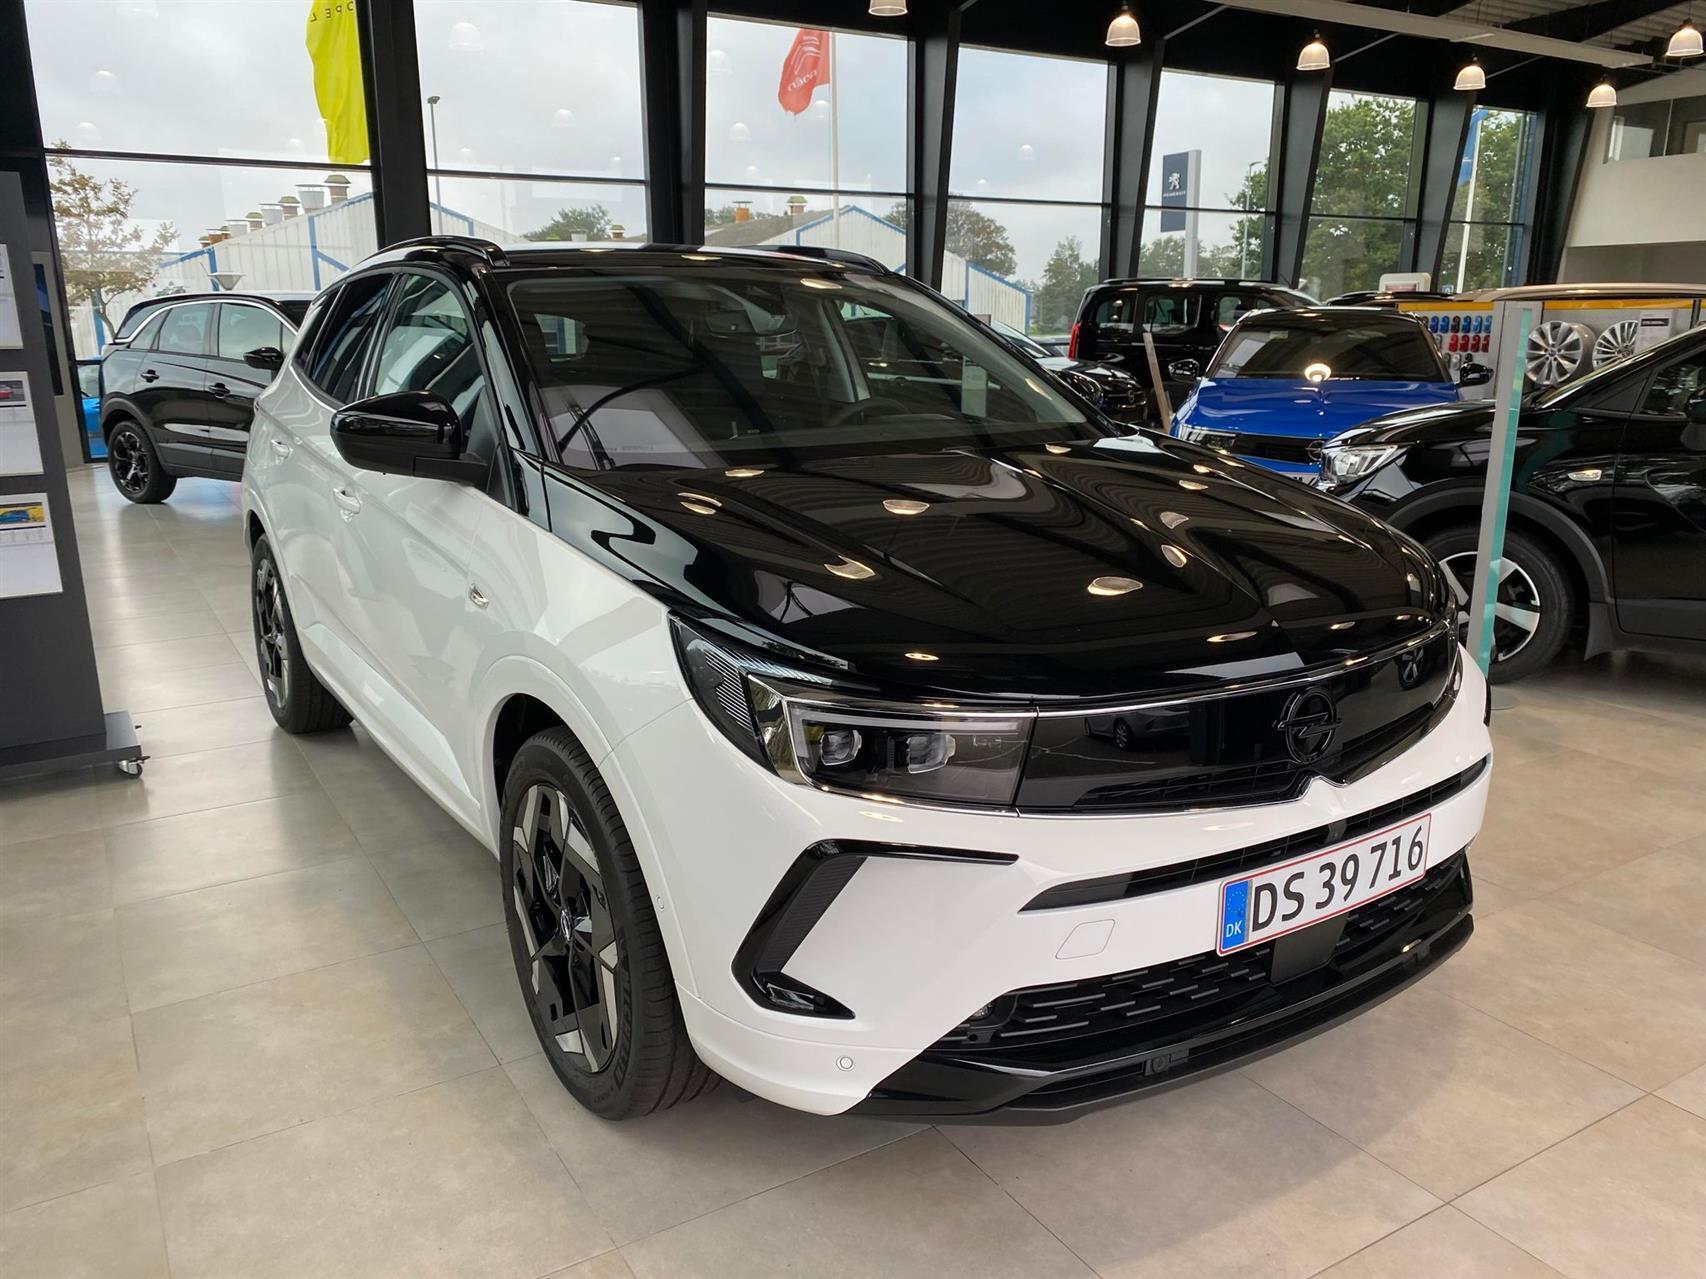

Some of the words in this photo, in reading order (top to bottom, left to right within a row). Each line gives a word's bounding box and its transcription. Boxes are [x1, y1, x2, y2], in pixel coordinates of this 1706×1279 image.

[1252, 871, 1305, 932] DS
[1315, 853, 1360, 910] 39
[1369, 826, 1424, 889] 716
[1225, 919, 1242, 938] DK
